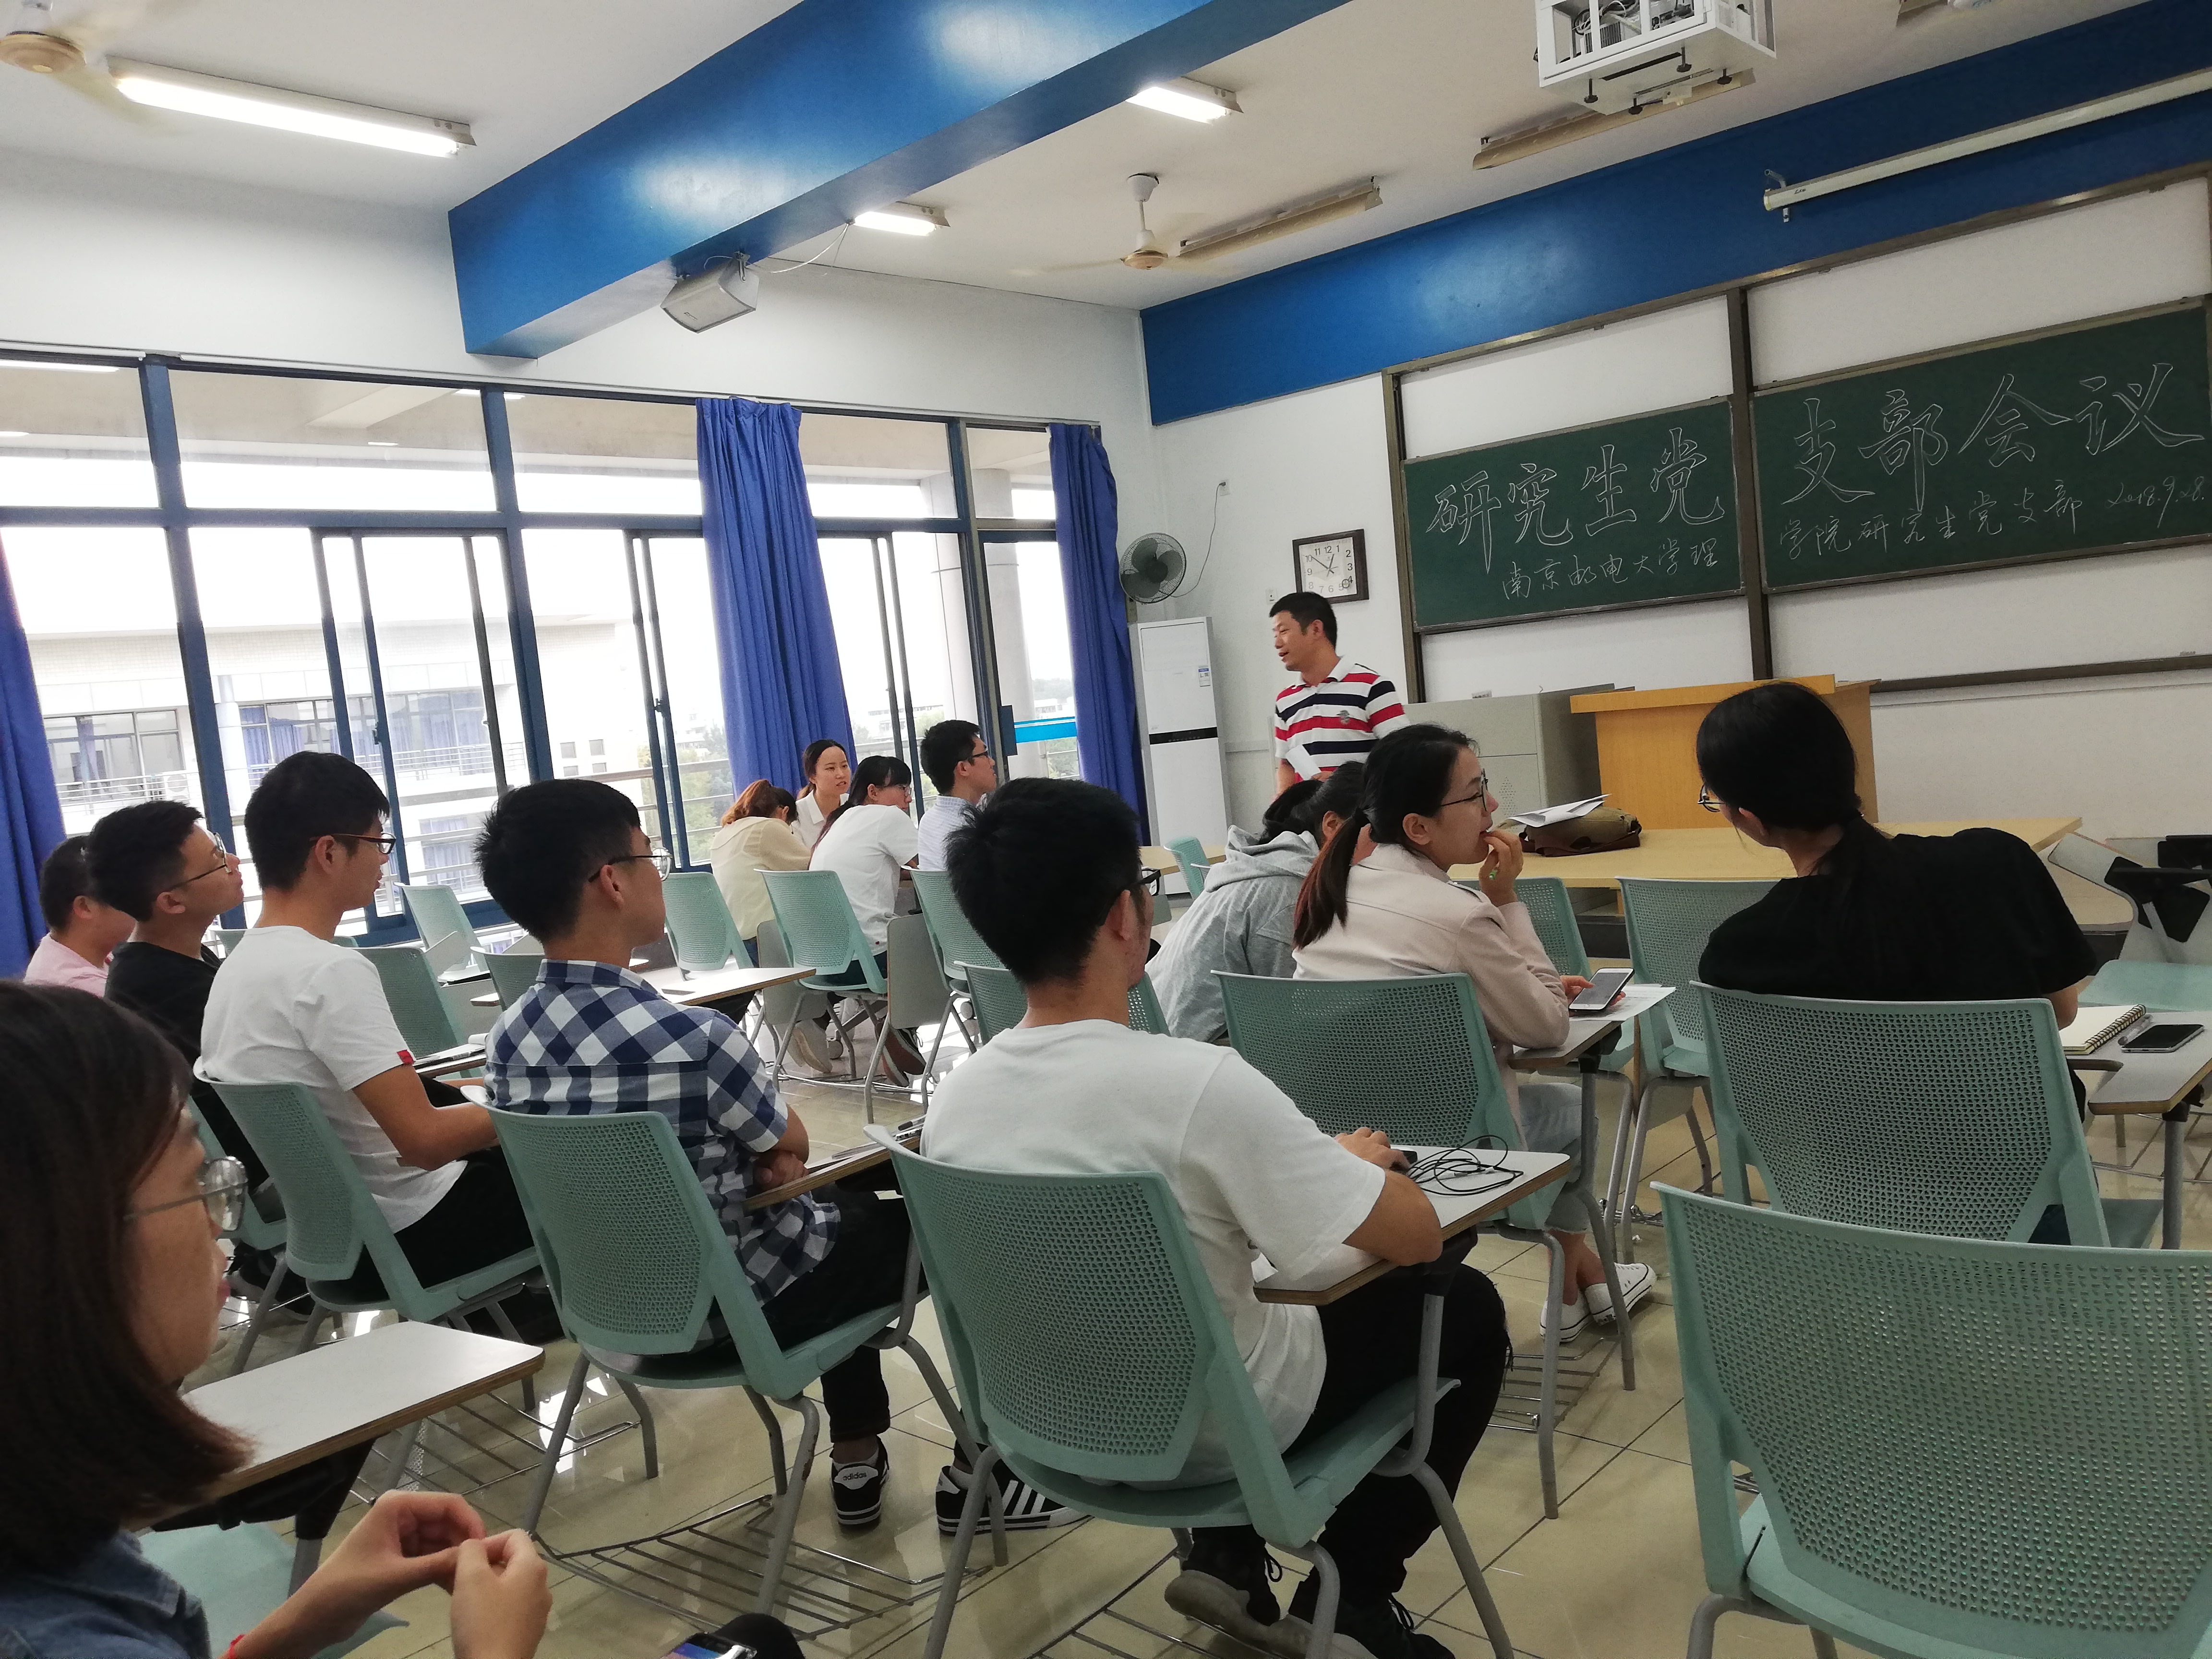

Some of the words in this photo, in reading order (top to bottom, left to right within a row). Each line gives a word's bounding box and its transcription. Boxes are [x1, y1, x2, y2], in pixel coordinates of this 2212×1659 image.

[1781, 363, 2205, 511] 支部会议
[1425, 427, 1725, 574] 研究生党
[1324, 545, 1332, 553] 12
[842, 1472, 866, 1481] adidas
